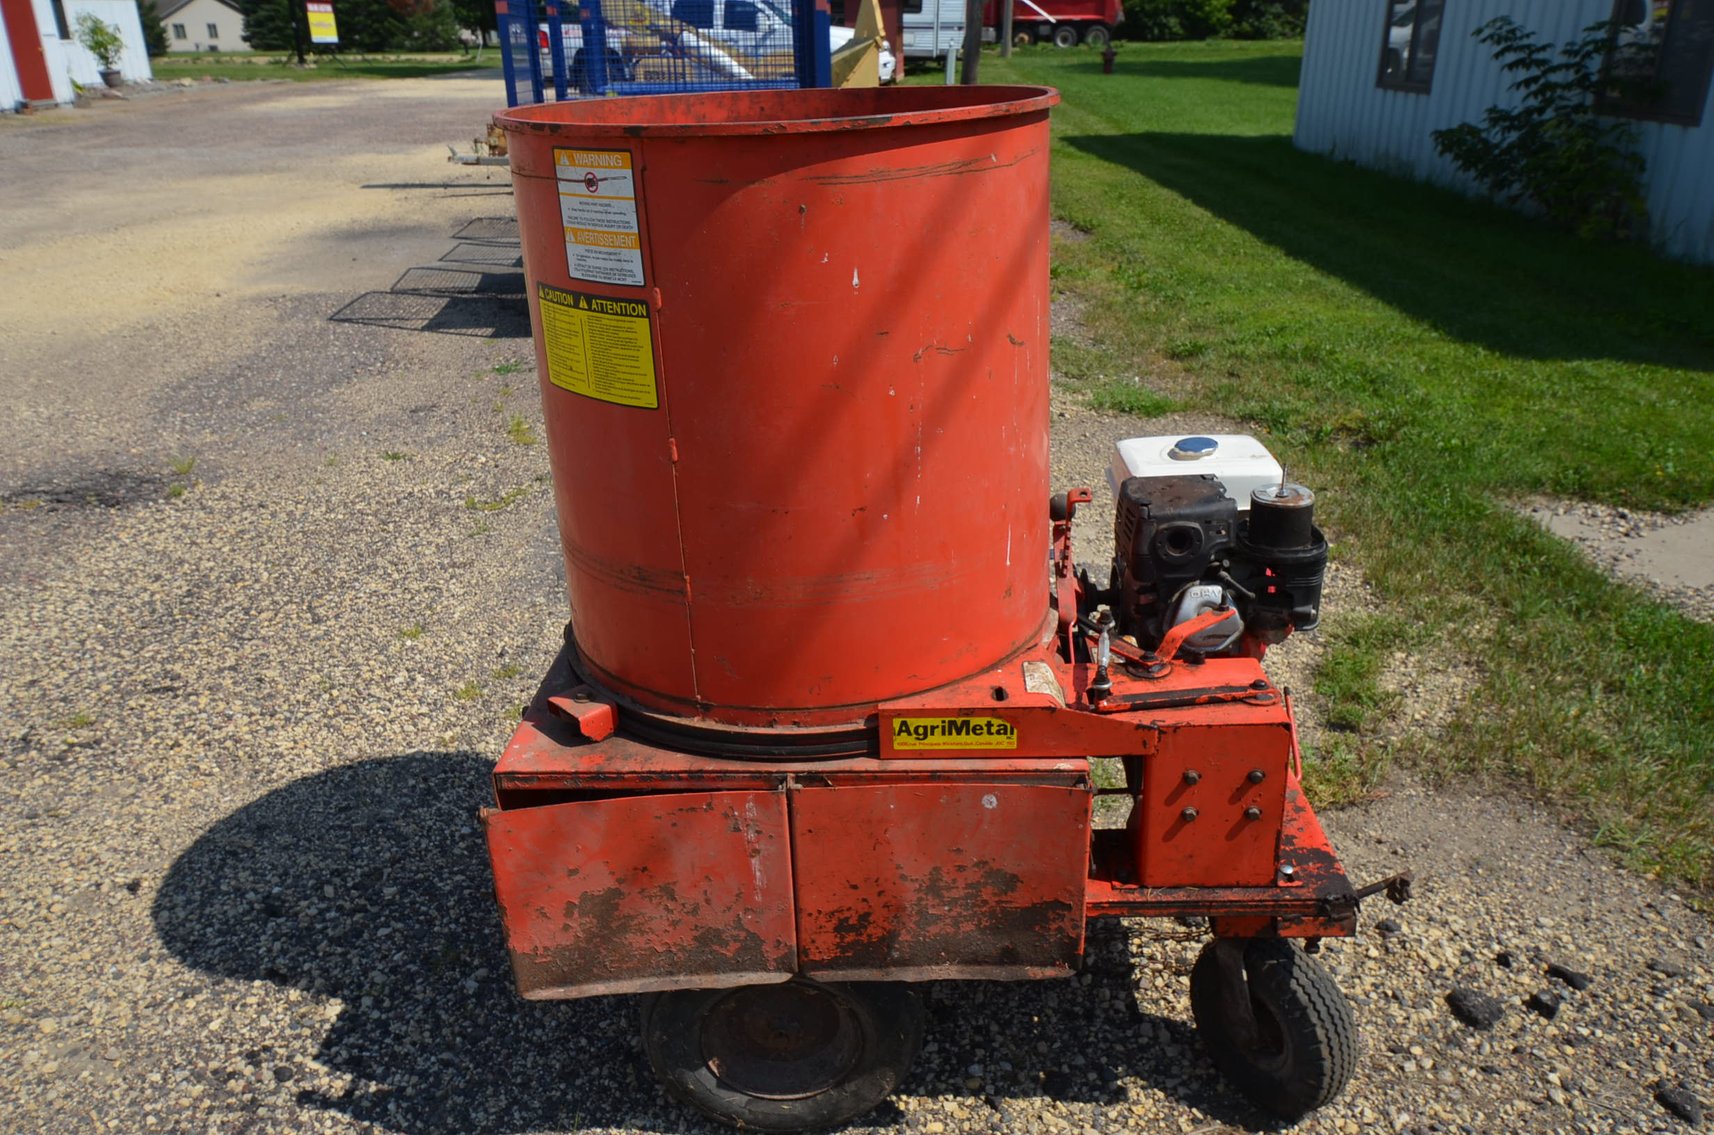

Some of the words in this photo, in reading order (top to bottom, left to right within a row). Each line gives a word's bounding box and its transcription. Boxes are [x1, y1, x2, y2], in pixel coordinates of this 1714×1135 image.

[573, 152, 622, 167] WARNING
[577, 231, 636, 247] AVERTISSEMENT
[544, 288, 574, 306] CAUTION
[591, 299, 647, 317] ATTENTION
